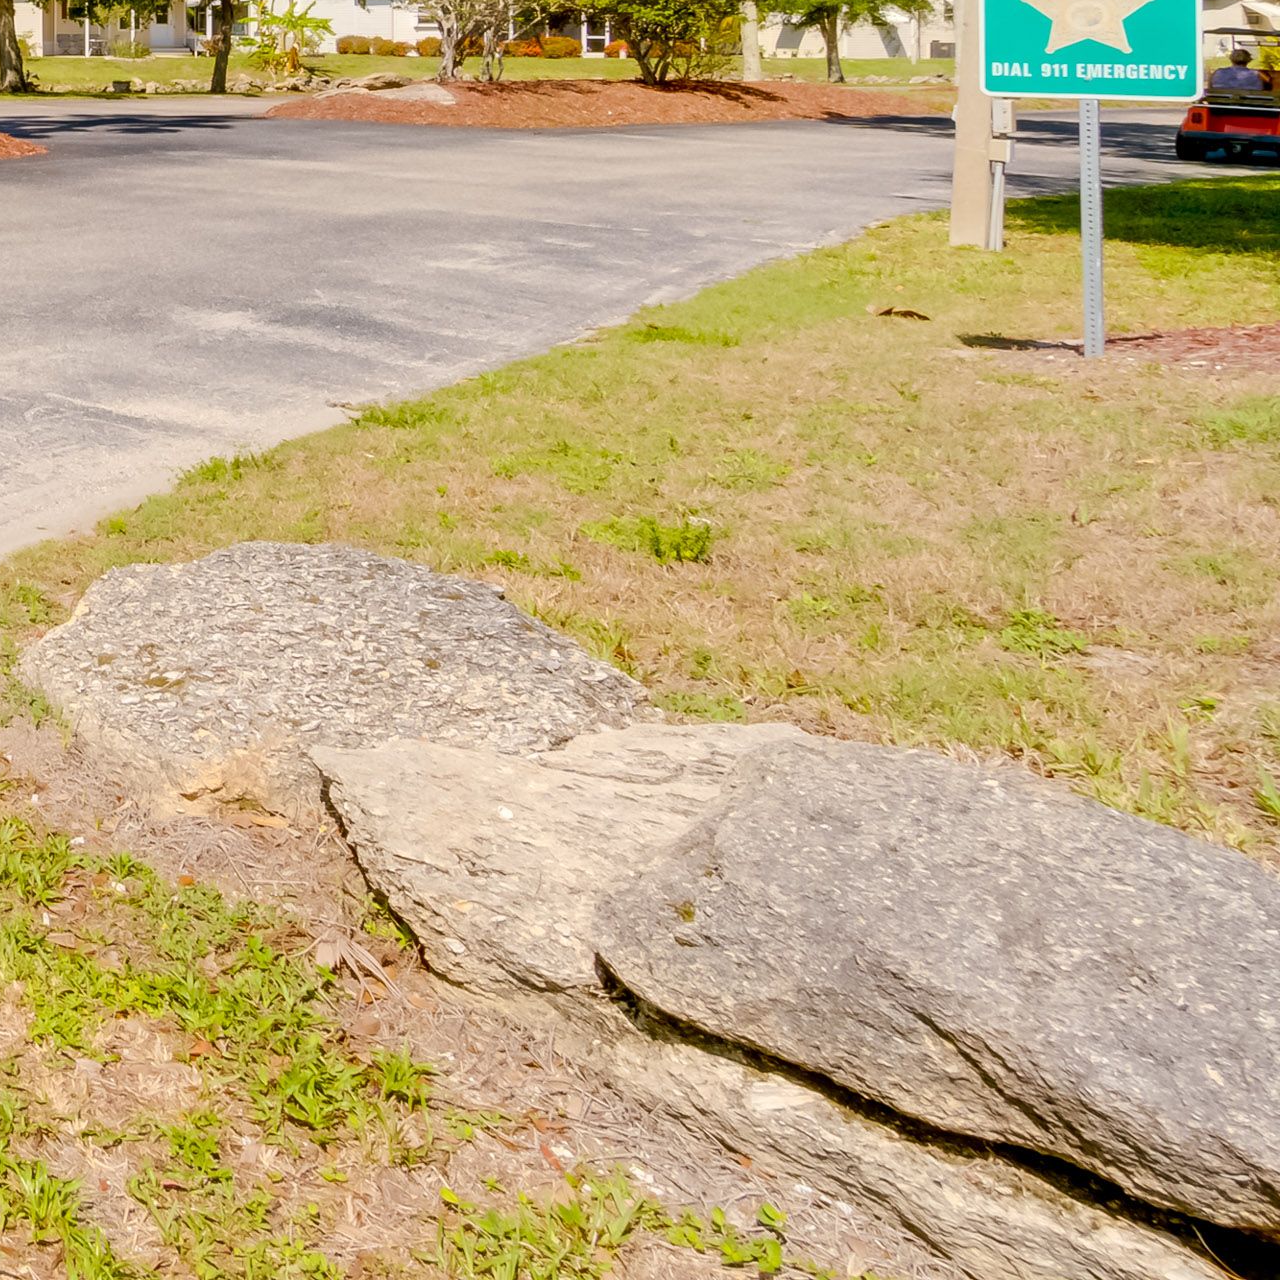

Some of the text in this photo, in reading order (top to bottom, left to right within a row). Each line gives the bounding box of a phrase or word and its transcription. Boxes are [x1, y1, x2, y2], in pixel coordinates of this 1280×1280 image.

[991, 62, 1189, 80] DIAL 911 EMERGENCY
